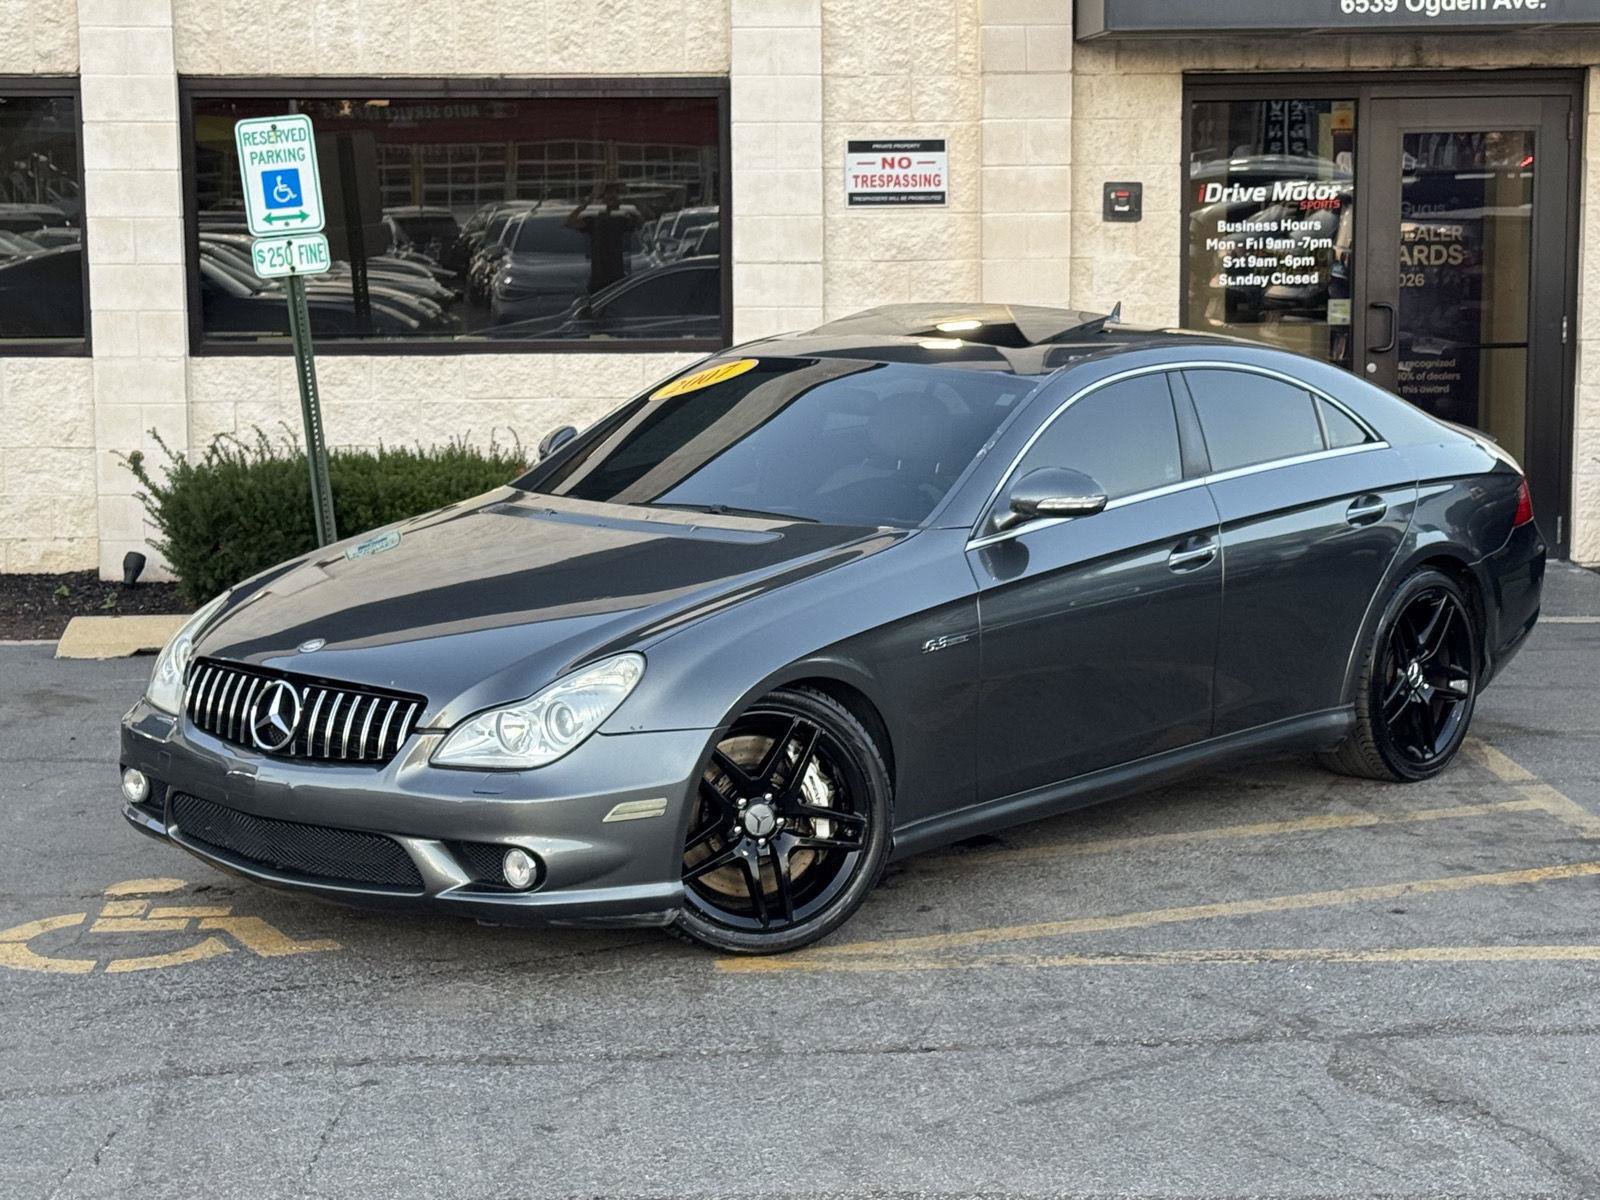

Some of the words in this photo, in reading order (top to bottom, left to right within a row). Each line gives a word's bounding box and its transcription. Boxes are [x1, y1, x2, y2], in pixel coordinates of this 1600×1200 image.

[1405, 0, 1487, 17] Ogden
[1492, 0, 1547, 10] Ave.
[243, 127, 307, 147] RESERVED
[250, 147, 306, 166] PARKING
[881, 156, 912, 170] NO
[853, 174, 942, 188] TRESPASSING
[1198, 182, 1267, 203] iDrive
[1271, 181, 1341, 201] Motor
[1300, 199, 1340, 210] SPORTS
[1217, 220, 1278, 233] Business
[1280, 219, 1322, 231] Hours
[1206, 238, 1236, 251] Mon
[1265, 237, 1295, 249] 9am
[257, 243, 293, 267] $250
[298, 243, 327, 265] FINE
[1223, 256, 1246, 269] Sat
[1248, 255, 1278, 267] 9am
[1219, 273, 1269, 288] Sunday
[1271, 272, 1320, 285] Closed
